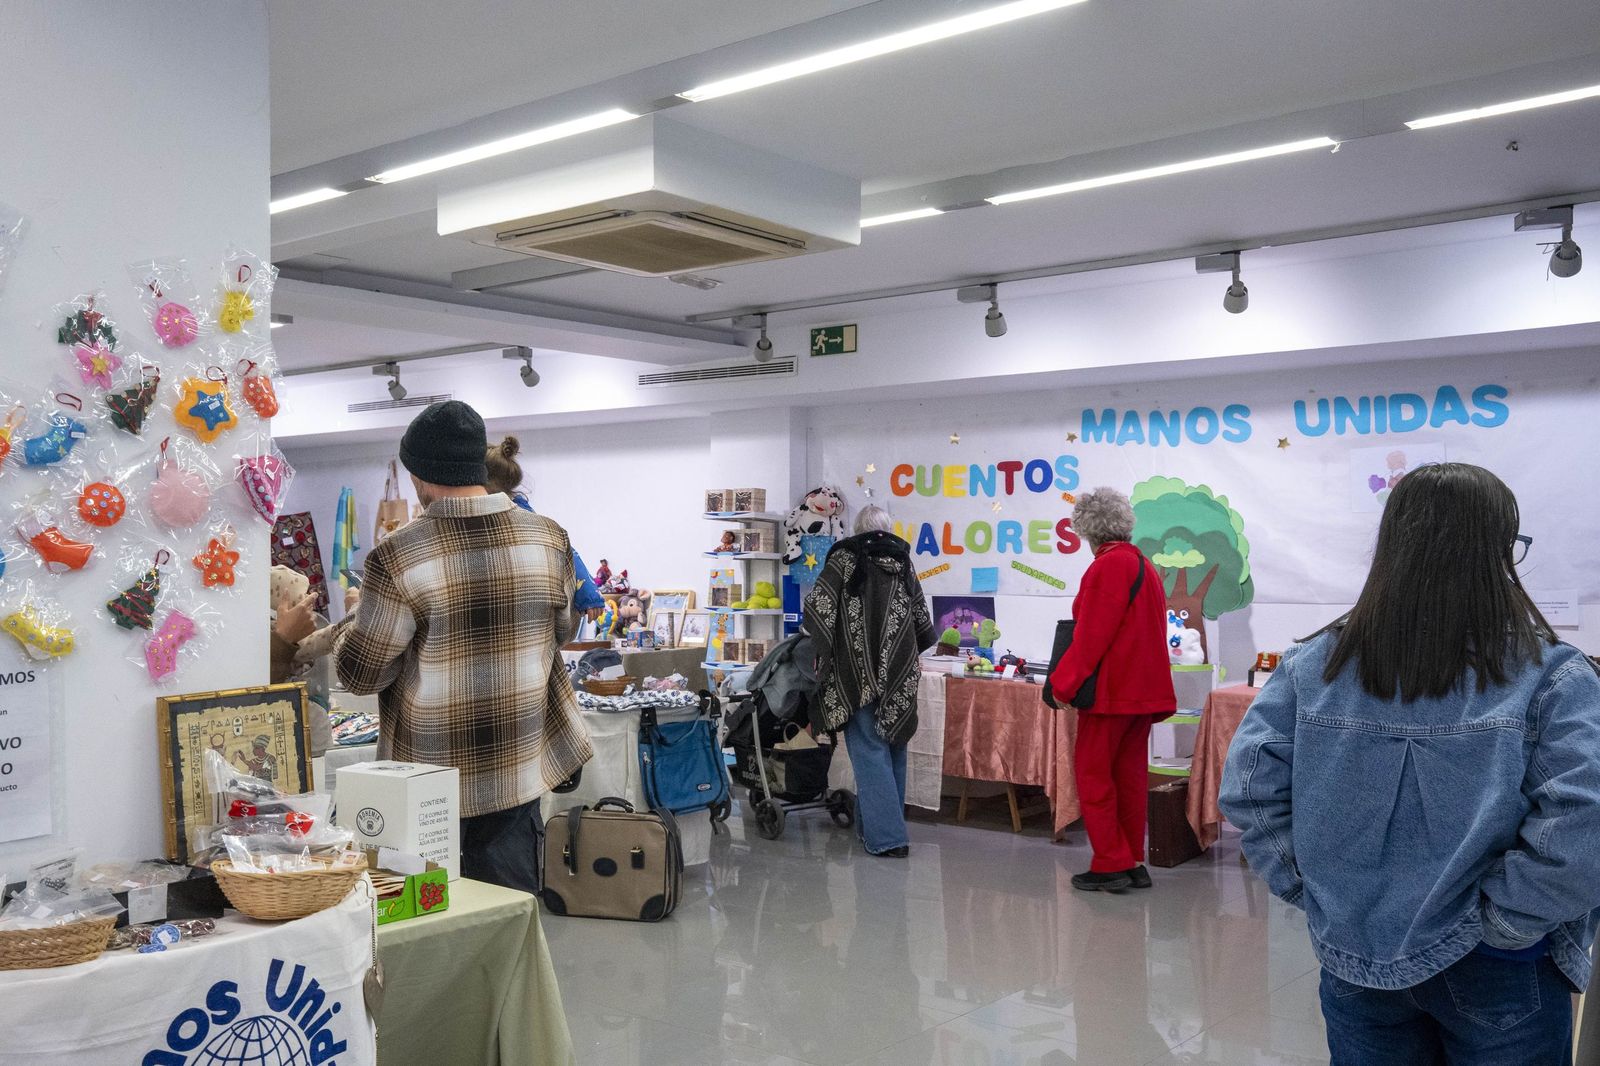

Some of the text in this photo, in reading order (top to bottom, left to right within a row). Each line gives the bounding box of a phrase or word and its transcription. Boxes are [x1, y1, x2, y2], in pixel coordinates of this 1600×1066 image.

[1080, 384, 1510, 448] MANOS UNIDAS
[890, 454, 1080, 498] CUENTOS
[1062, 492, 1076, 505] IGU
[917, 563, 950, 580] ESPETO
[1011, 560, 1066, 590] SOLIDARIDAD
[0, 670, 35, 686] MOS
[1, 762, 13, 775] O
[359, 810, 380, 821] BOHEMIA
[266, 958, 347, 1066] Unid
